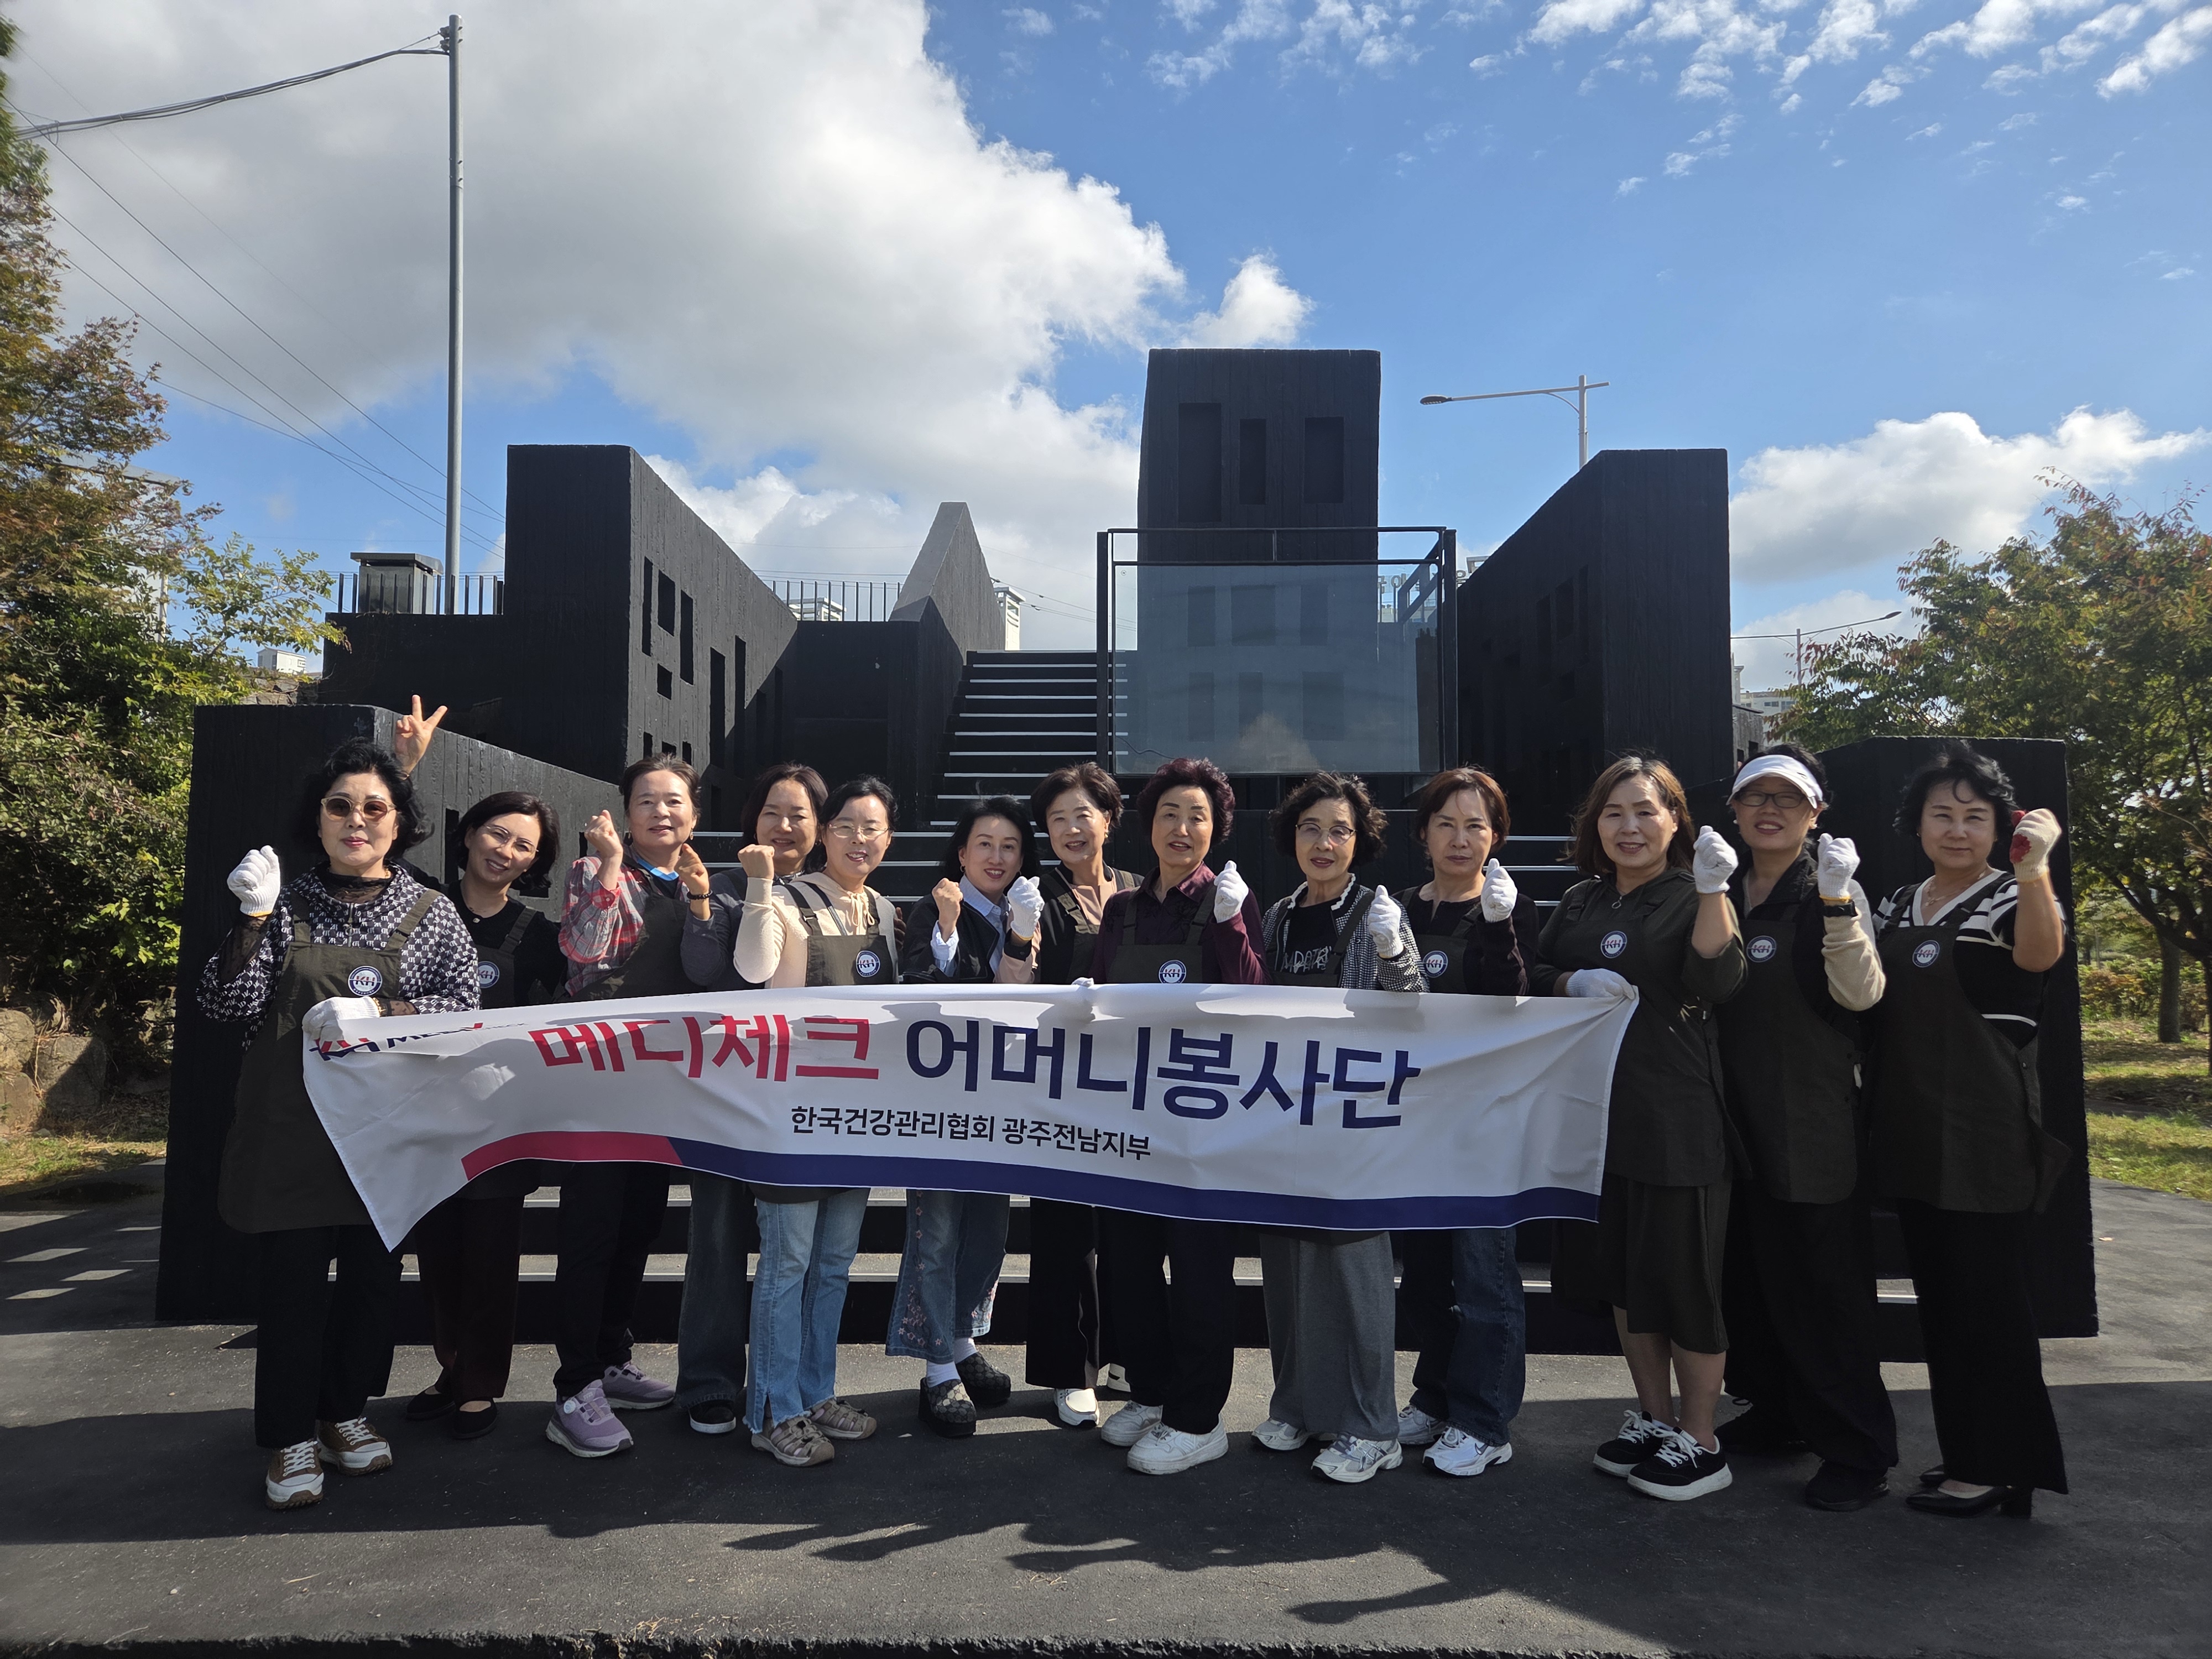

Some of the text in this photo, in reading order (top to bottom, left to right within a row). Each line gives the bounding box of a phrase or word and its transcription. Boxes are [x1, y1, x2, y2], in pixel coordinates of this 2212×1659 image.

[528, 1014, 1421, 1129] 메디체크 어머니봉사단
[791, 1106, 1151, 1161] 한국건강관리협회 광주전남지부
